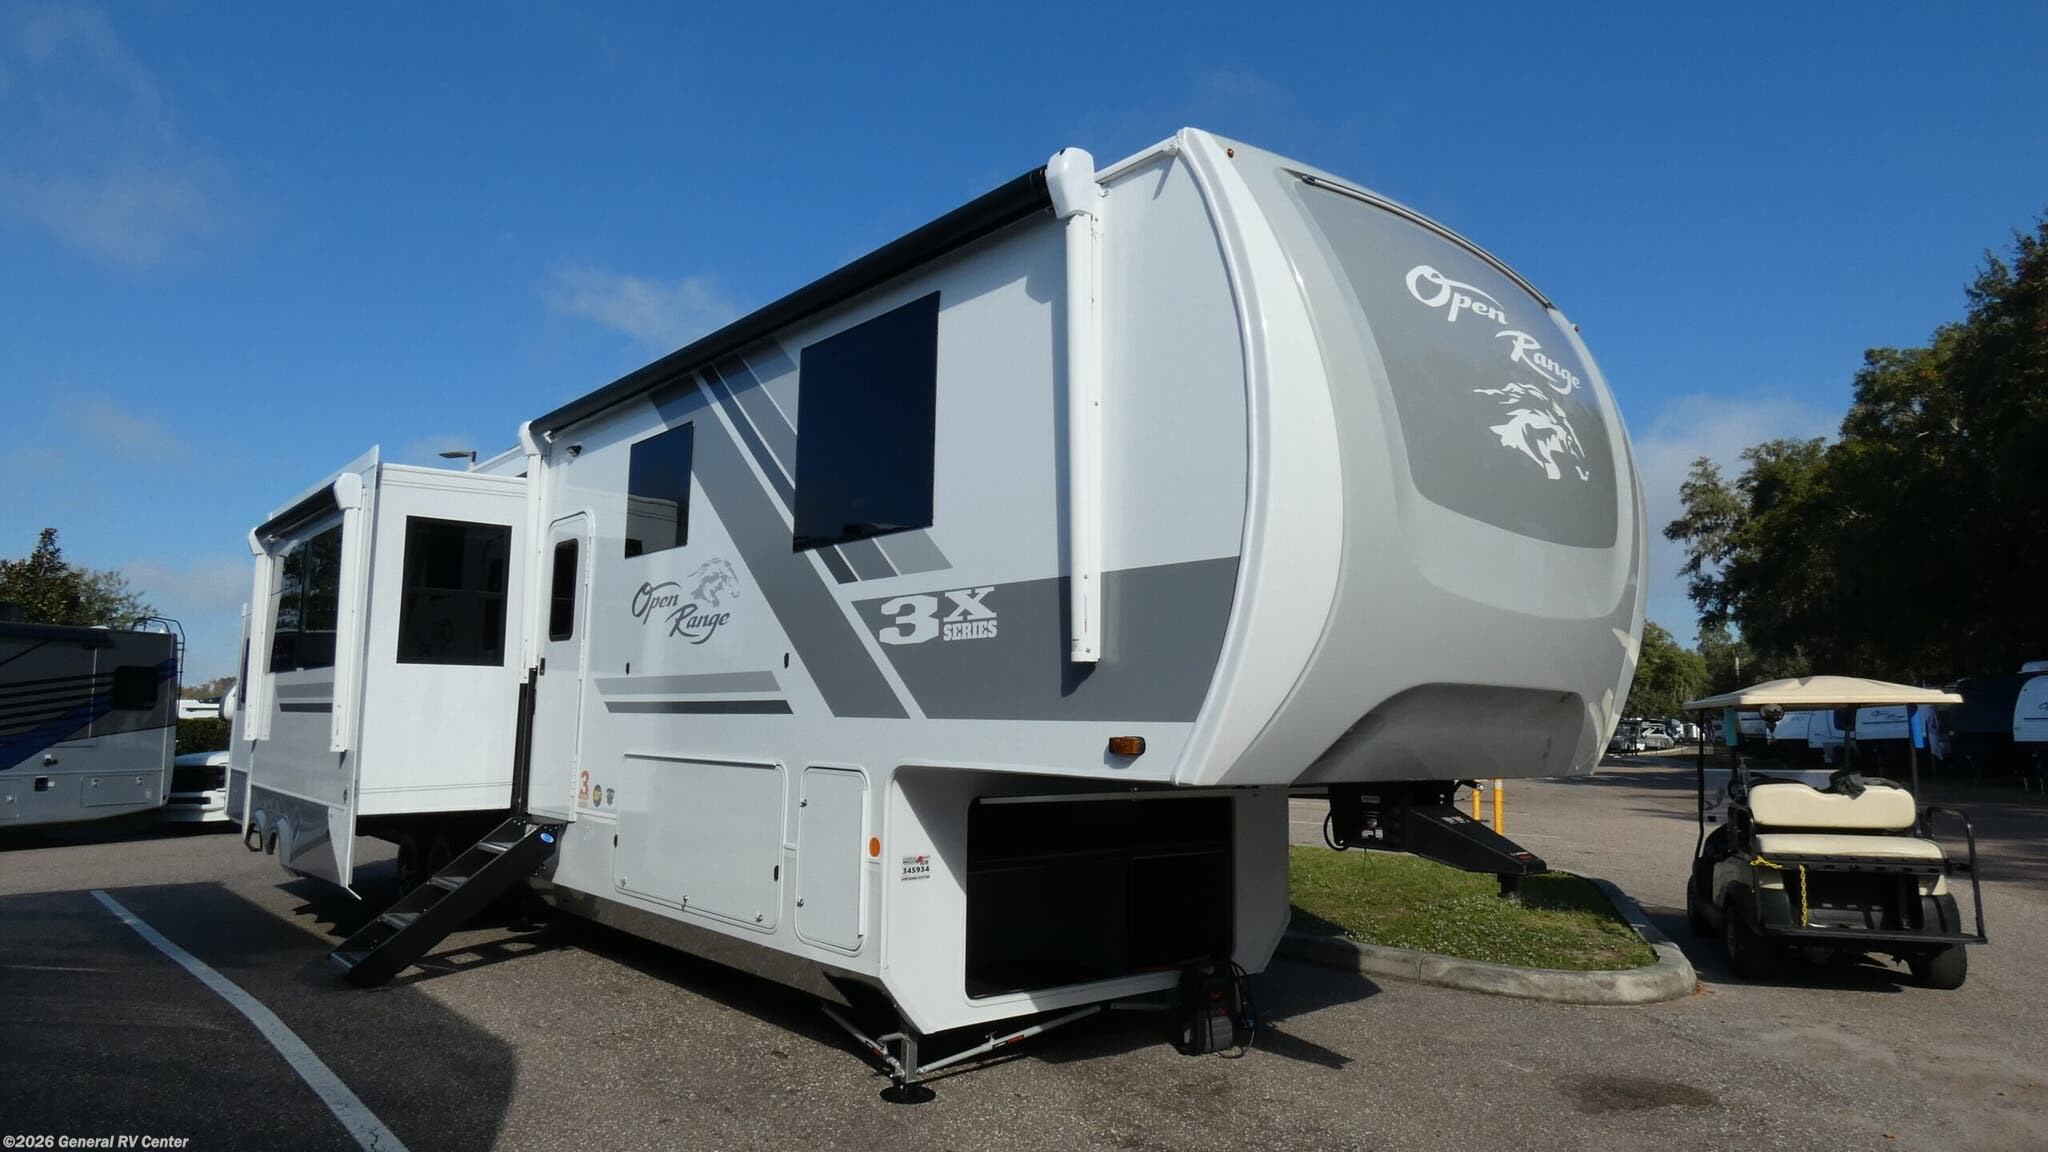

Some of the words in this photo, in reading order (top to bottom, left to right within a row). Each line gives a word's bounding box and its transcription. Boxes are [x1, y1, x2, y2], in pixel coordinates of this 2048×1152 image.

[1405, 264, 1509, 325] Open
[1495, 330, 1582, 395] Range
[631, 581, 682, 625] Open
[664, 603, 731, 645] Range
[943, 619, 998, 642] SERIES
[902, 866, 930, 875] 345934
